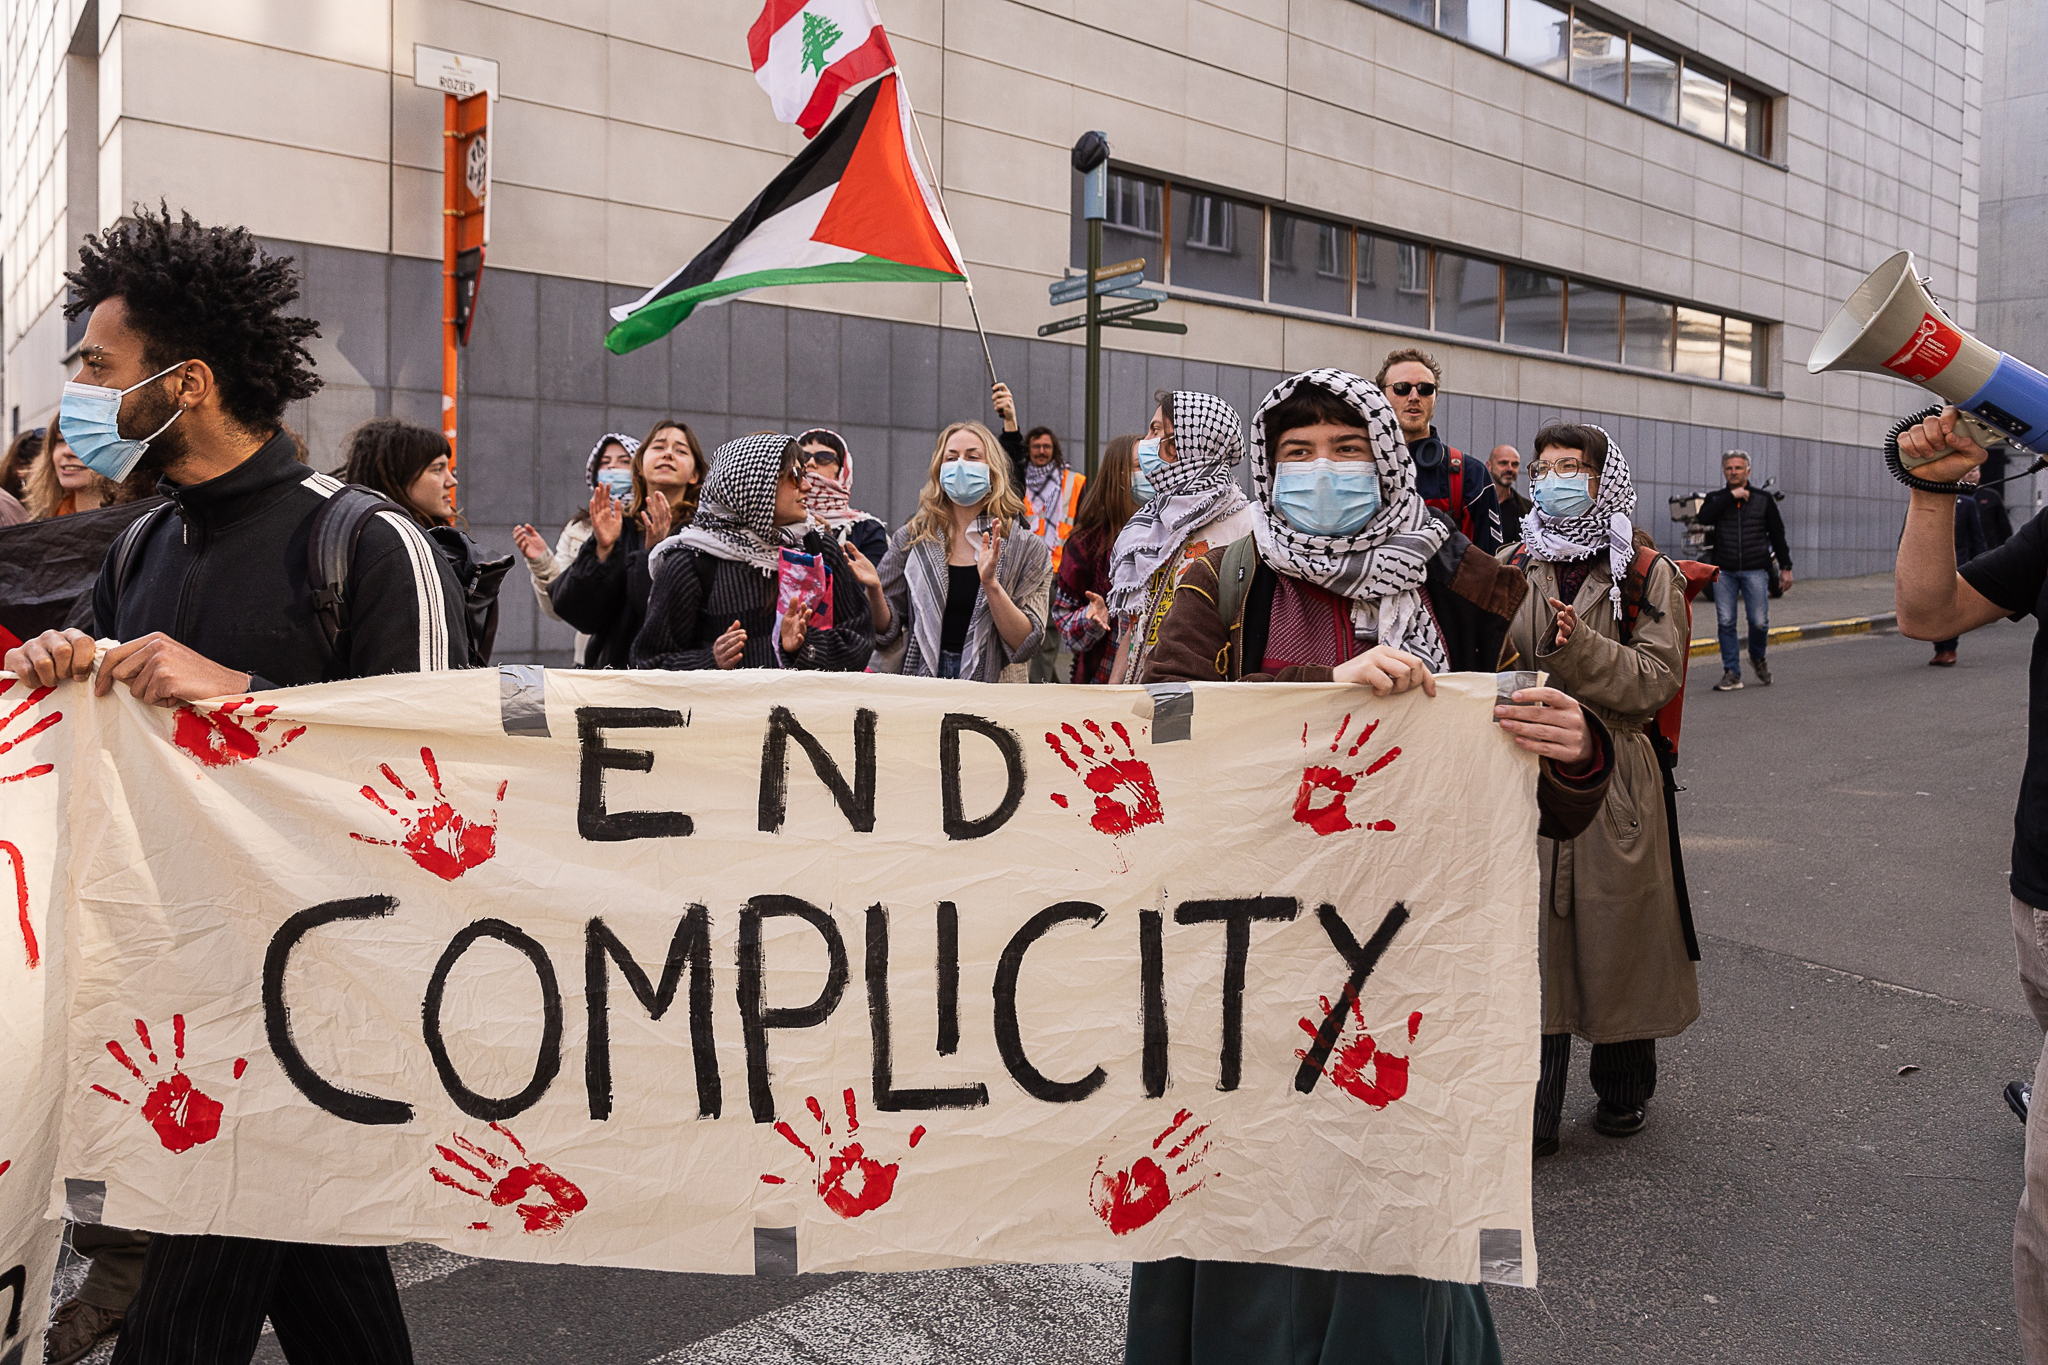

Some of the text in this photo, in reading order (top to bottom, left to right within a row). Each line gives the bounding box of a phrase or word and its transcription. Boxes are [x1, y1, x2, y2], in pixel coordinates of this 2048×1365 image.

[439, 75, 476, 93] ROZIER
[575, 706, 1026, 841] END
[262, 893, 1409, 1125] COMPLICITY
